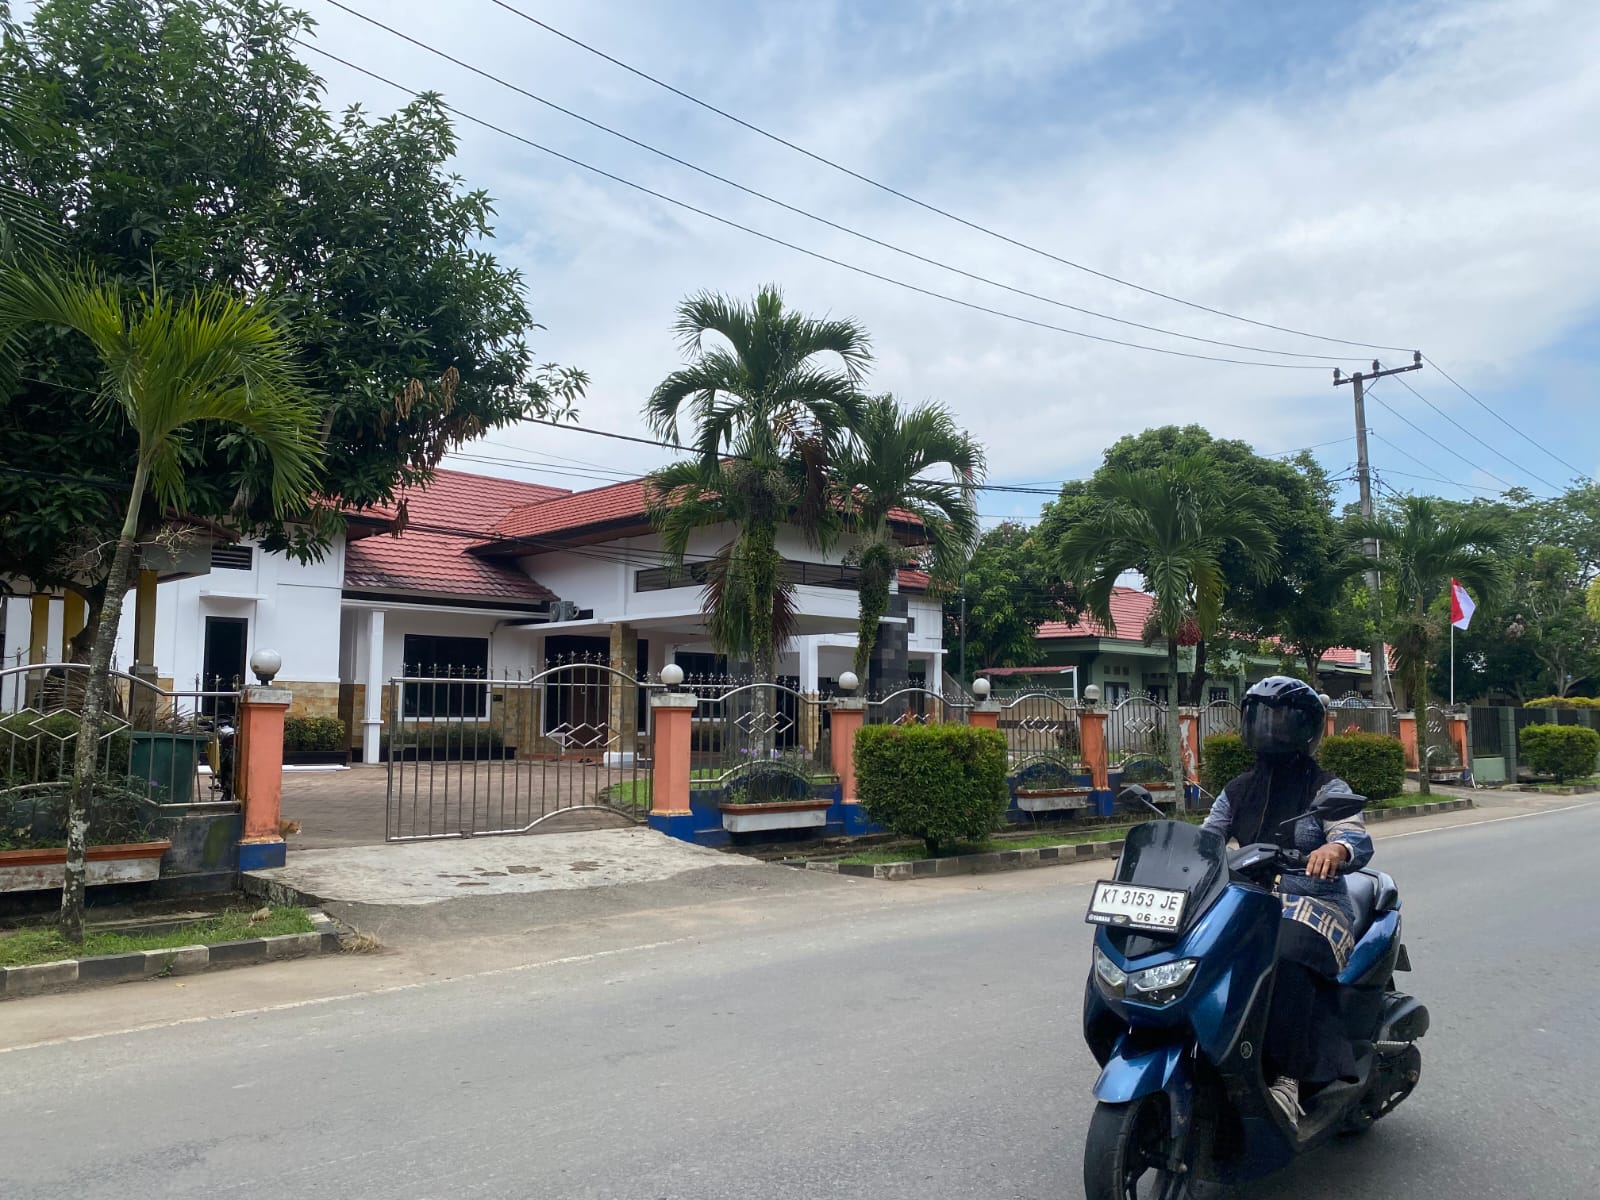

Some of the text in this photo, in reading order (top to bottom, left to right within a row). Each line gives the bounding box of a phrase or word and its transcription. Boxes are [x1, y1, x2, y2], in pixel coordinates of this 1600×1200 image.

[1101, 888, 1179, 911] KT 3153 JE
